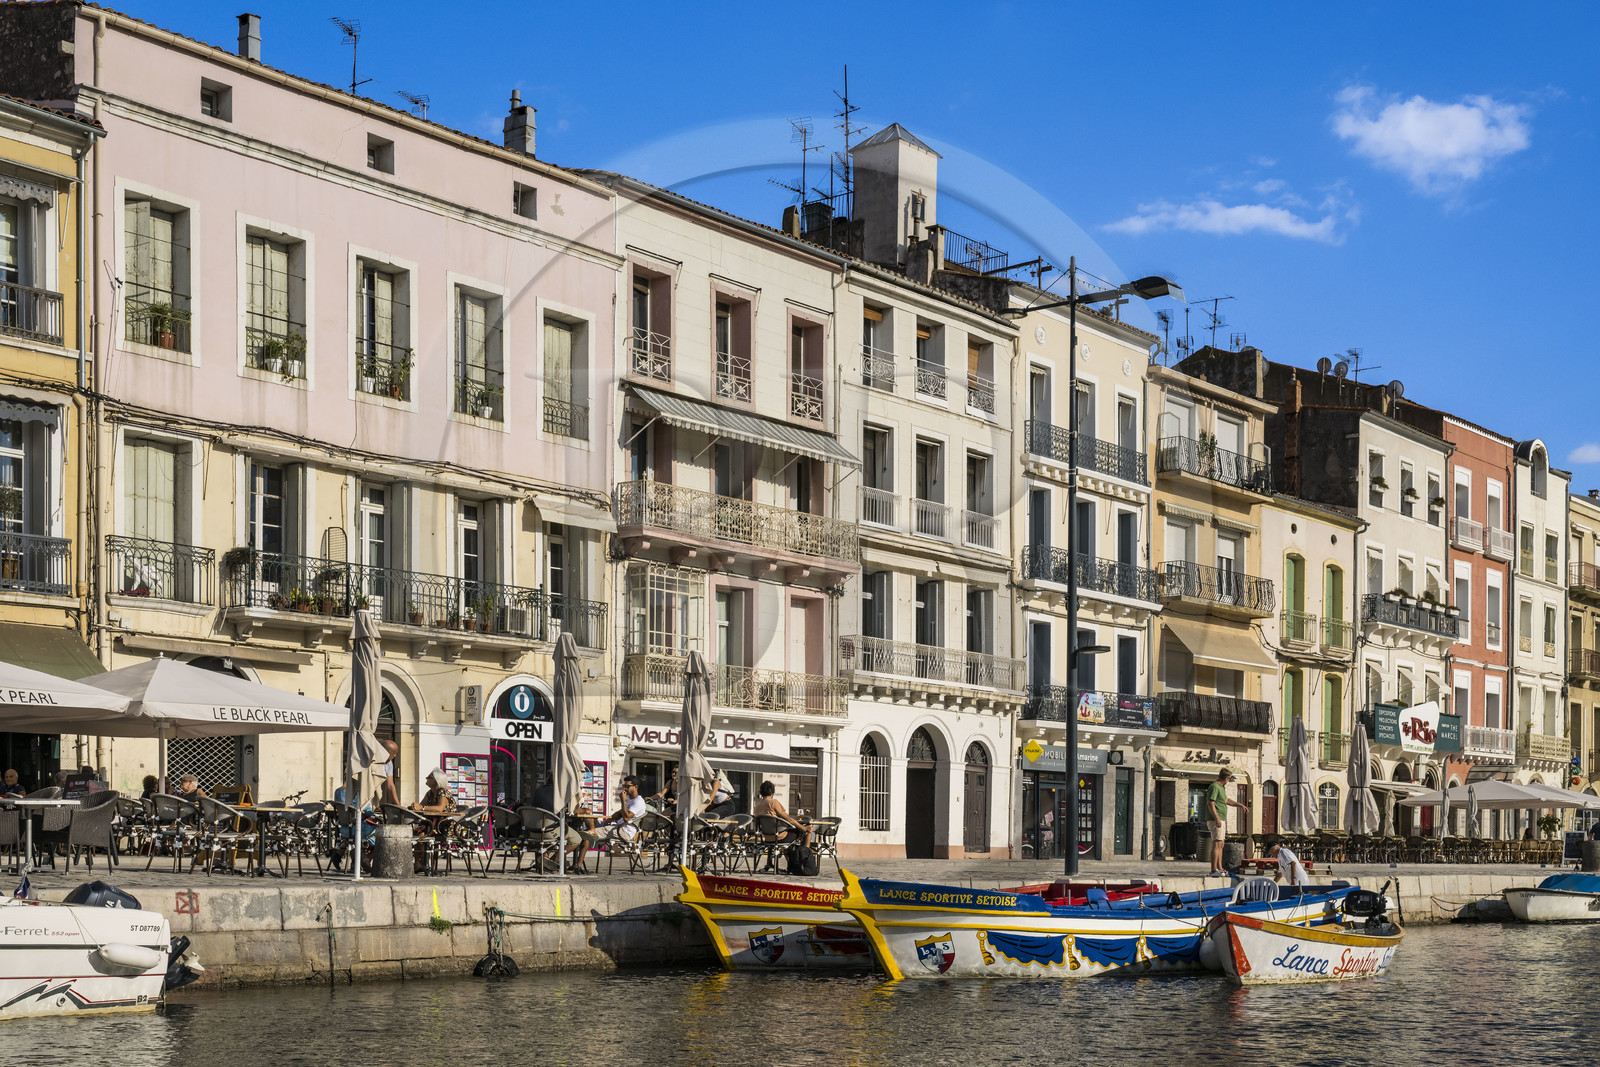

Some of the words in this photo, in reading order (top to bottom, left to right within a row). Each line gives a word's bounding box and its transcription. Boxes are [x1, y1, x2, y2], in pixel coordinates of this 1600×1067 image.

[8, 690, 58, 705] PEARL
[213, 707, 227, 720] LE
[230, 708, 271, 722] BLACK
[274, 710, 312, 725] PEARL
[505, 721, 543, 739] OPEN
[631, 726, 682, 745] Meubl
[706, 731, 718, 747] &
[724, 733, 764, 751] Déco
[1410, 716, 1437, 745] Rio
[714, 883, 749, 896] LANCE
[753, 887, 804, 900] SPORTIVE
[879, 888, 917, 900] LANCE
[920, 891, 974, 904] SPORTIVE
[976, 894, 1017, 907] SETOISE
[1272, 943, 1329, 975] Lance
[136, 995, 148, 1003] B2
